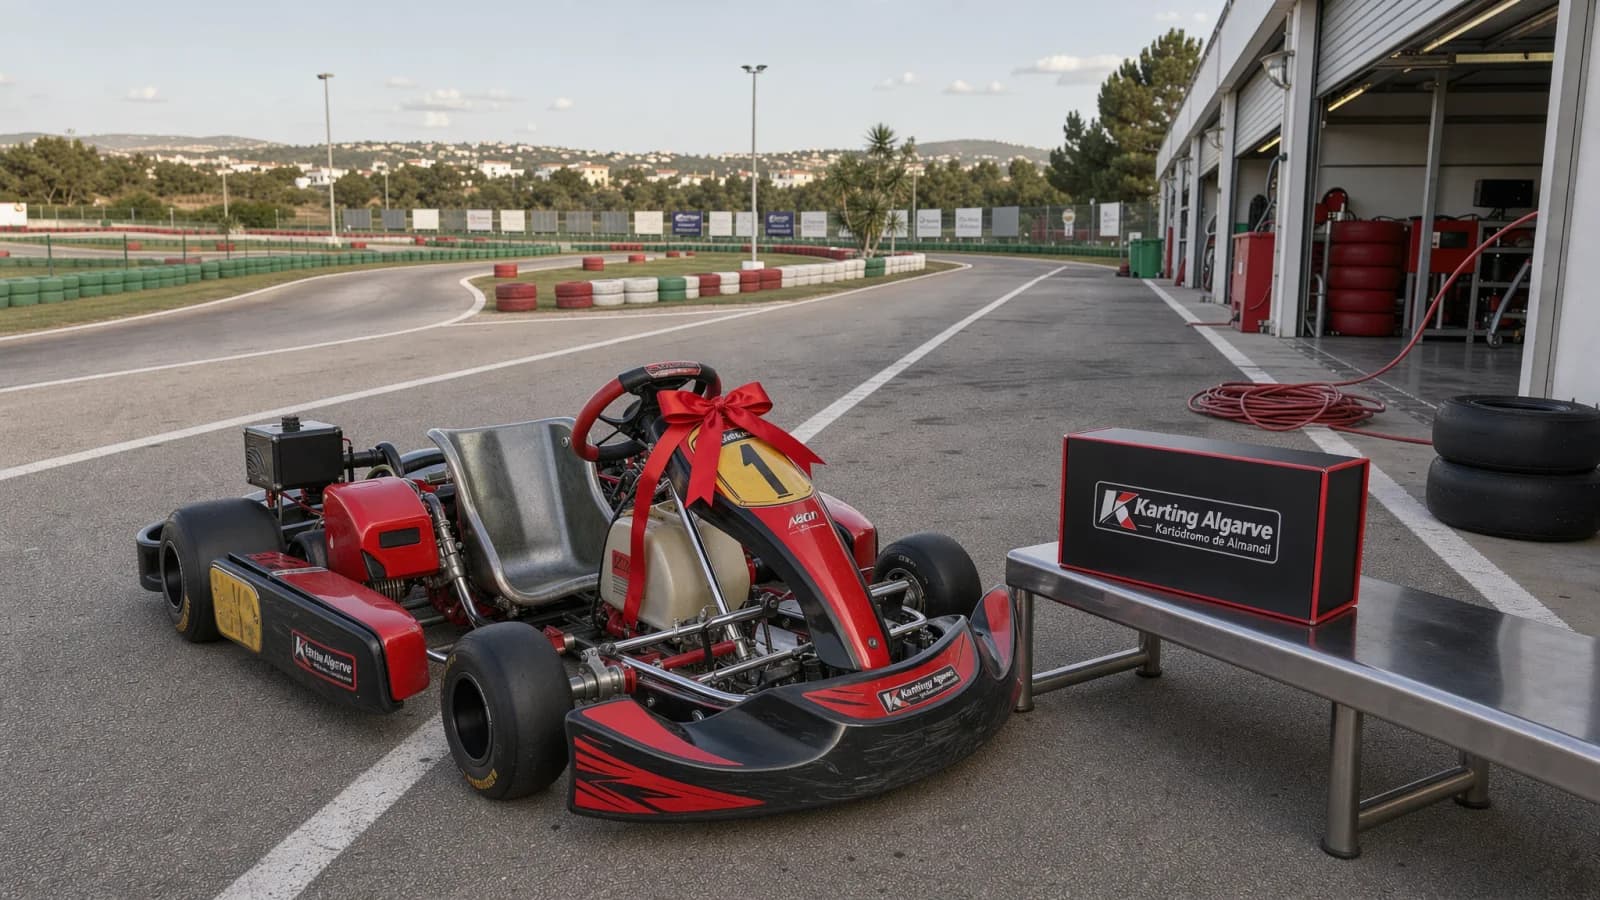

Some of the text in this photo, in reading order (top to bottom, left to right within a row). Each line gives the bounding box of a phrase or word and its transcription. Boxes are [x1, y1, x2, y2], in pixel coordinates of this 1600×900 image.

[740, 443, 794, 499] 1
[1134, 497, 1273, 540] Karting Algarve
[1212, 535, 1225, 547] de
[1226, 537, 1272, 556] Almancil
